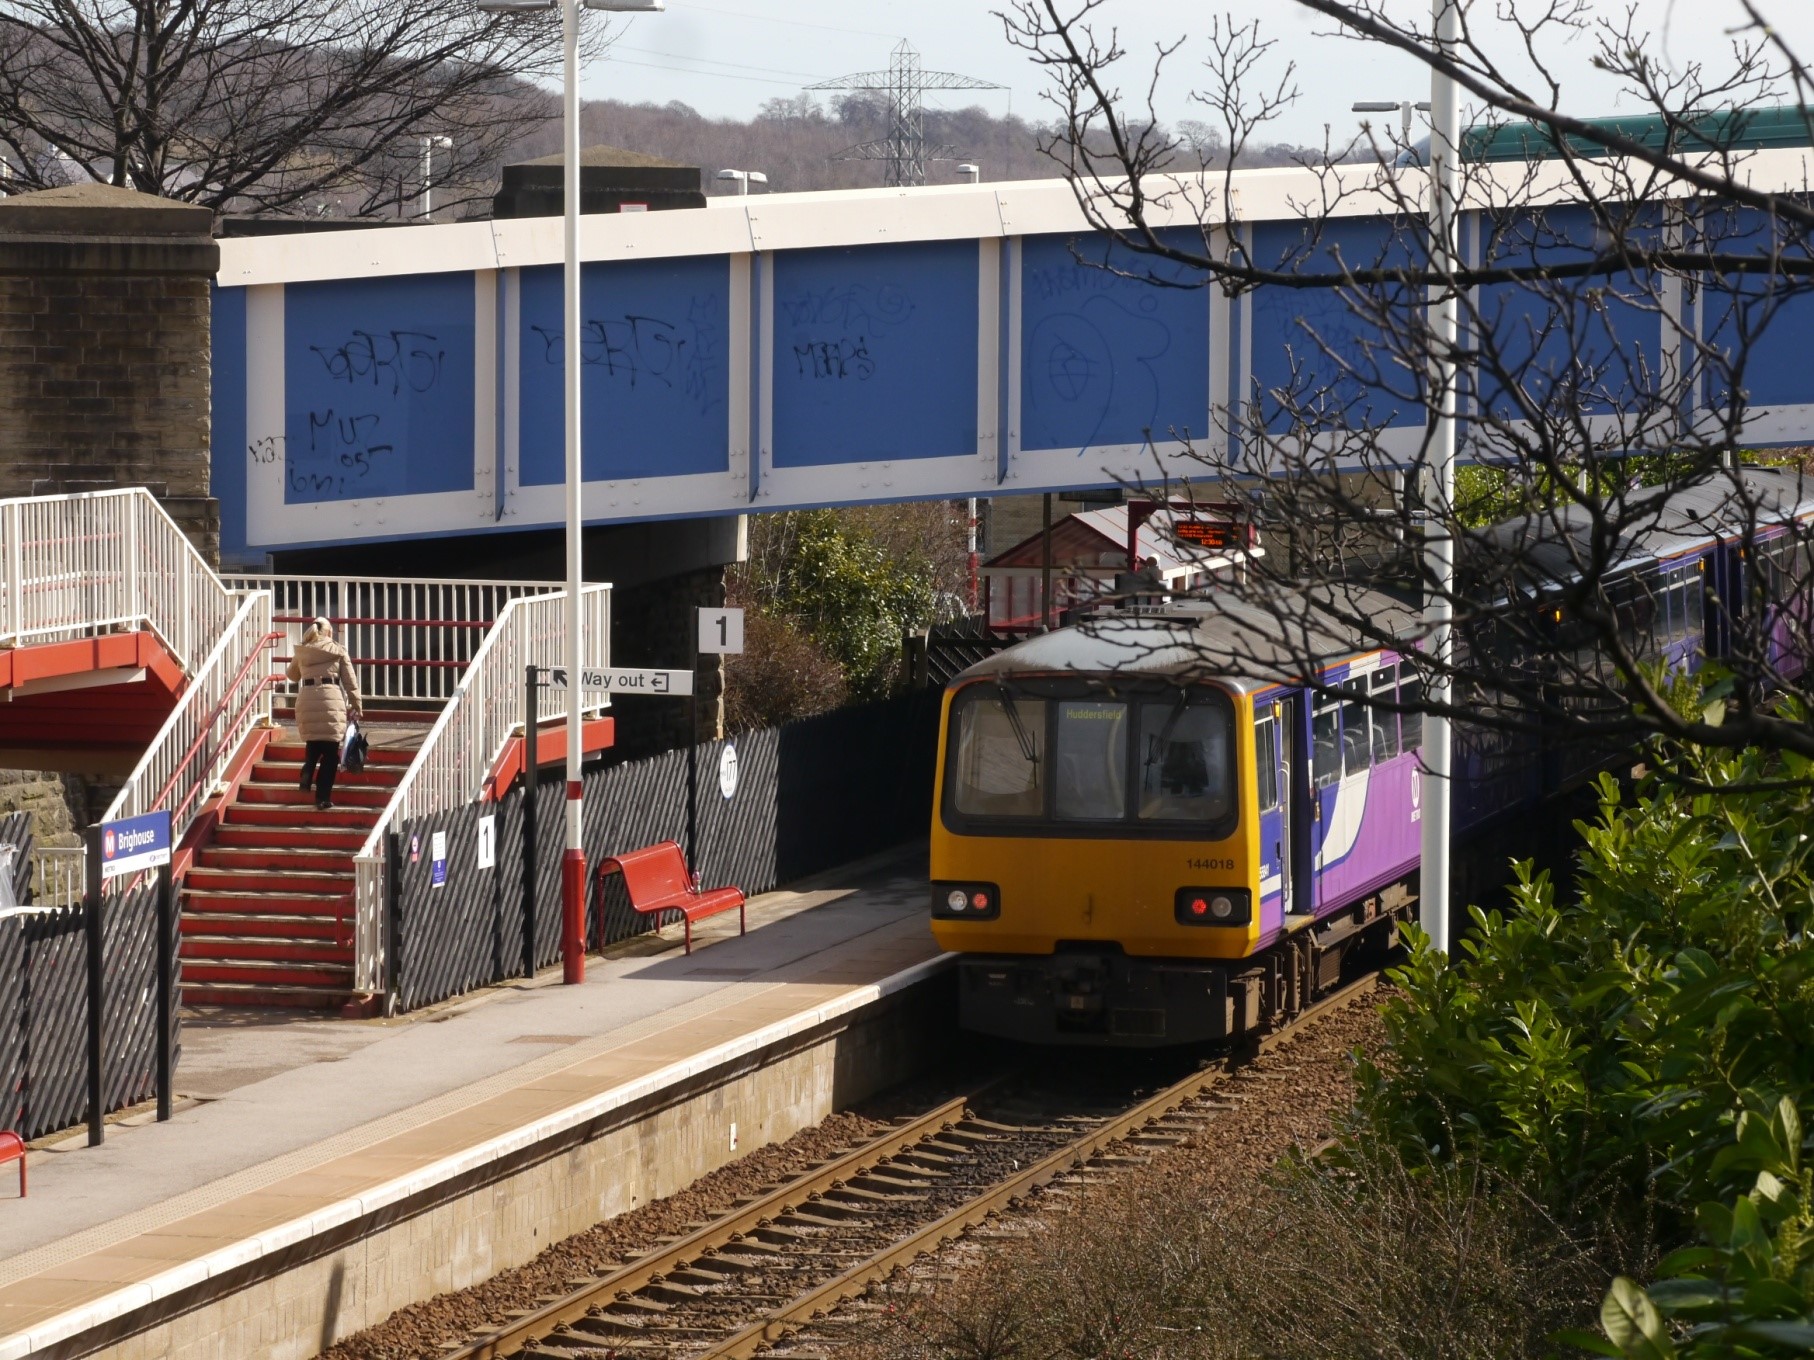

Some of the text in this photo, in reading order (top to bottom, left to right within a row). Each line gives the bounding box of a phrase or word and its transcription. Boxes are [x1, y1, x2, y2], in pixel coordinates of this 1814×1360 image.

[715, 615, 727, 647] 1
[582, 671, 645, 689] Way out
[1066, 708, 1122, 720] Huddersfield
[118, 829, 154, 852] Brighouse
[483, 825, 489, 859] 1
[1186, 858, 1235, 870] 144018
